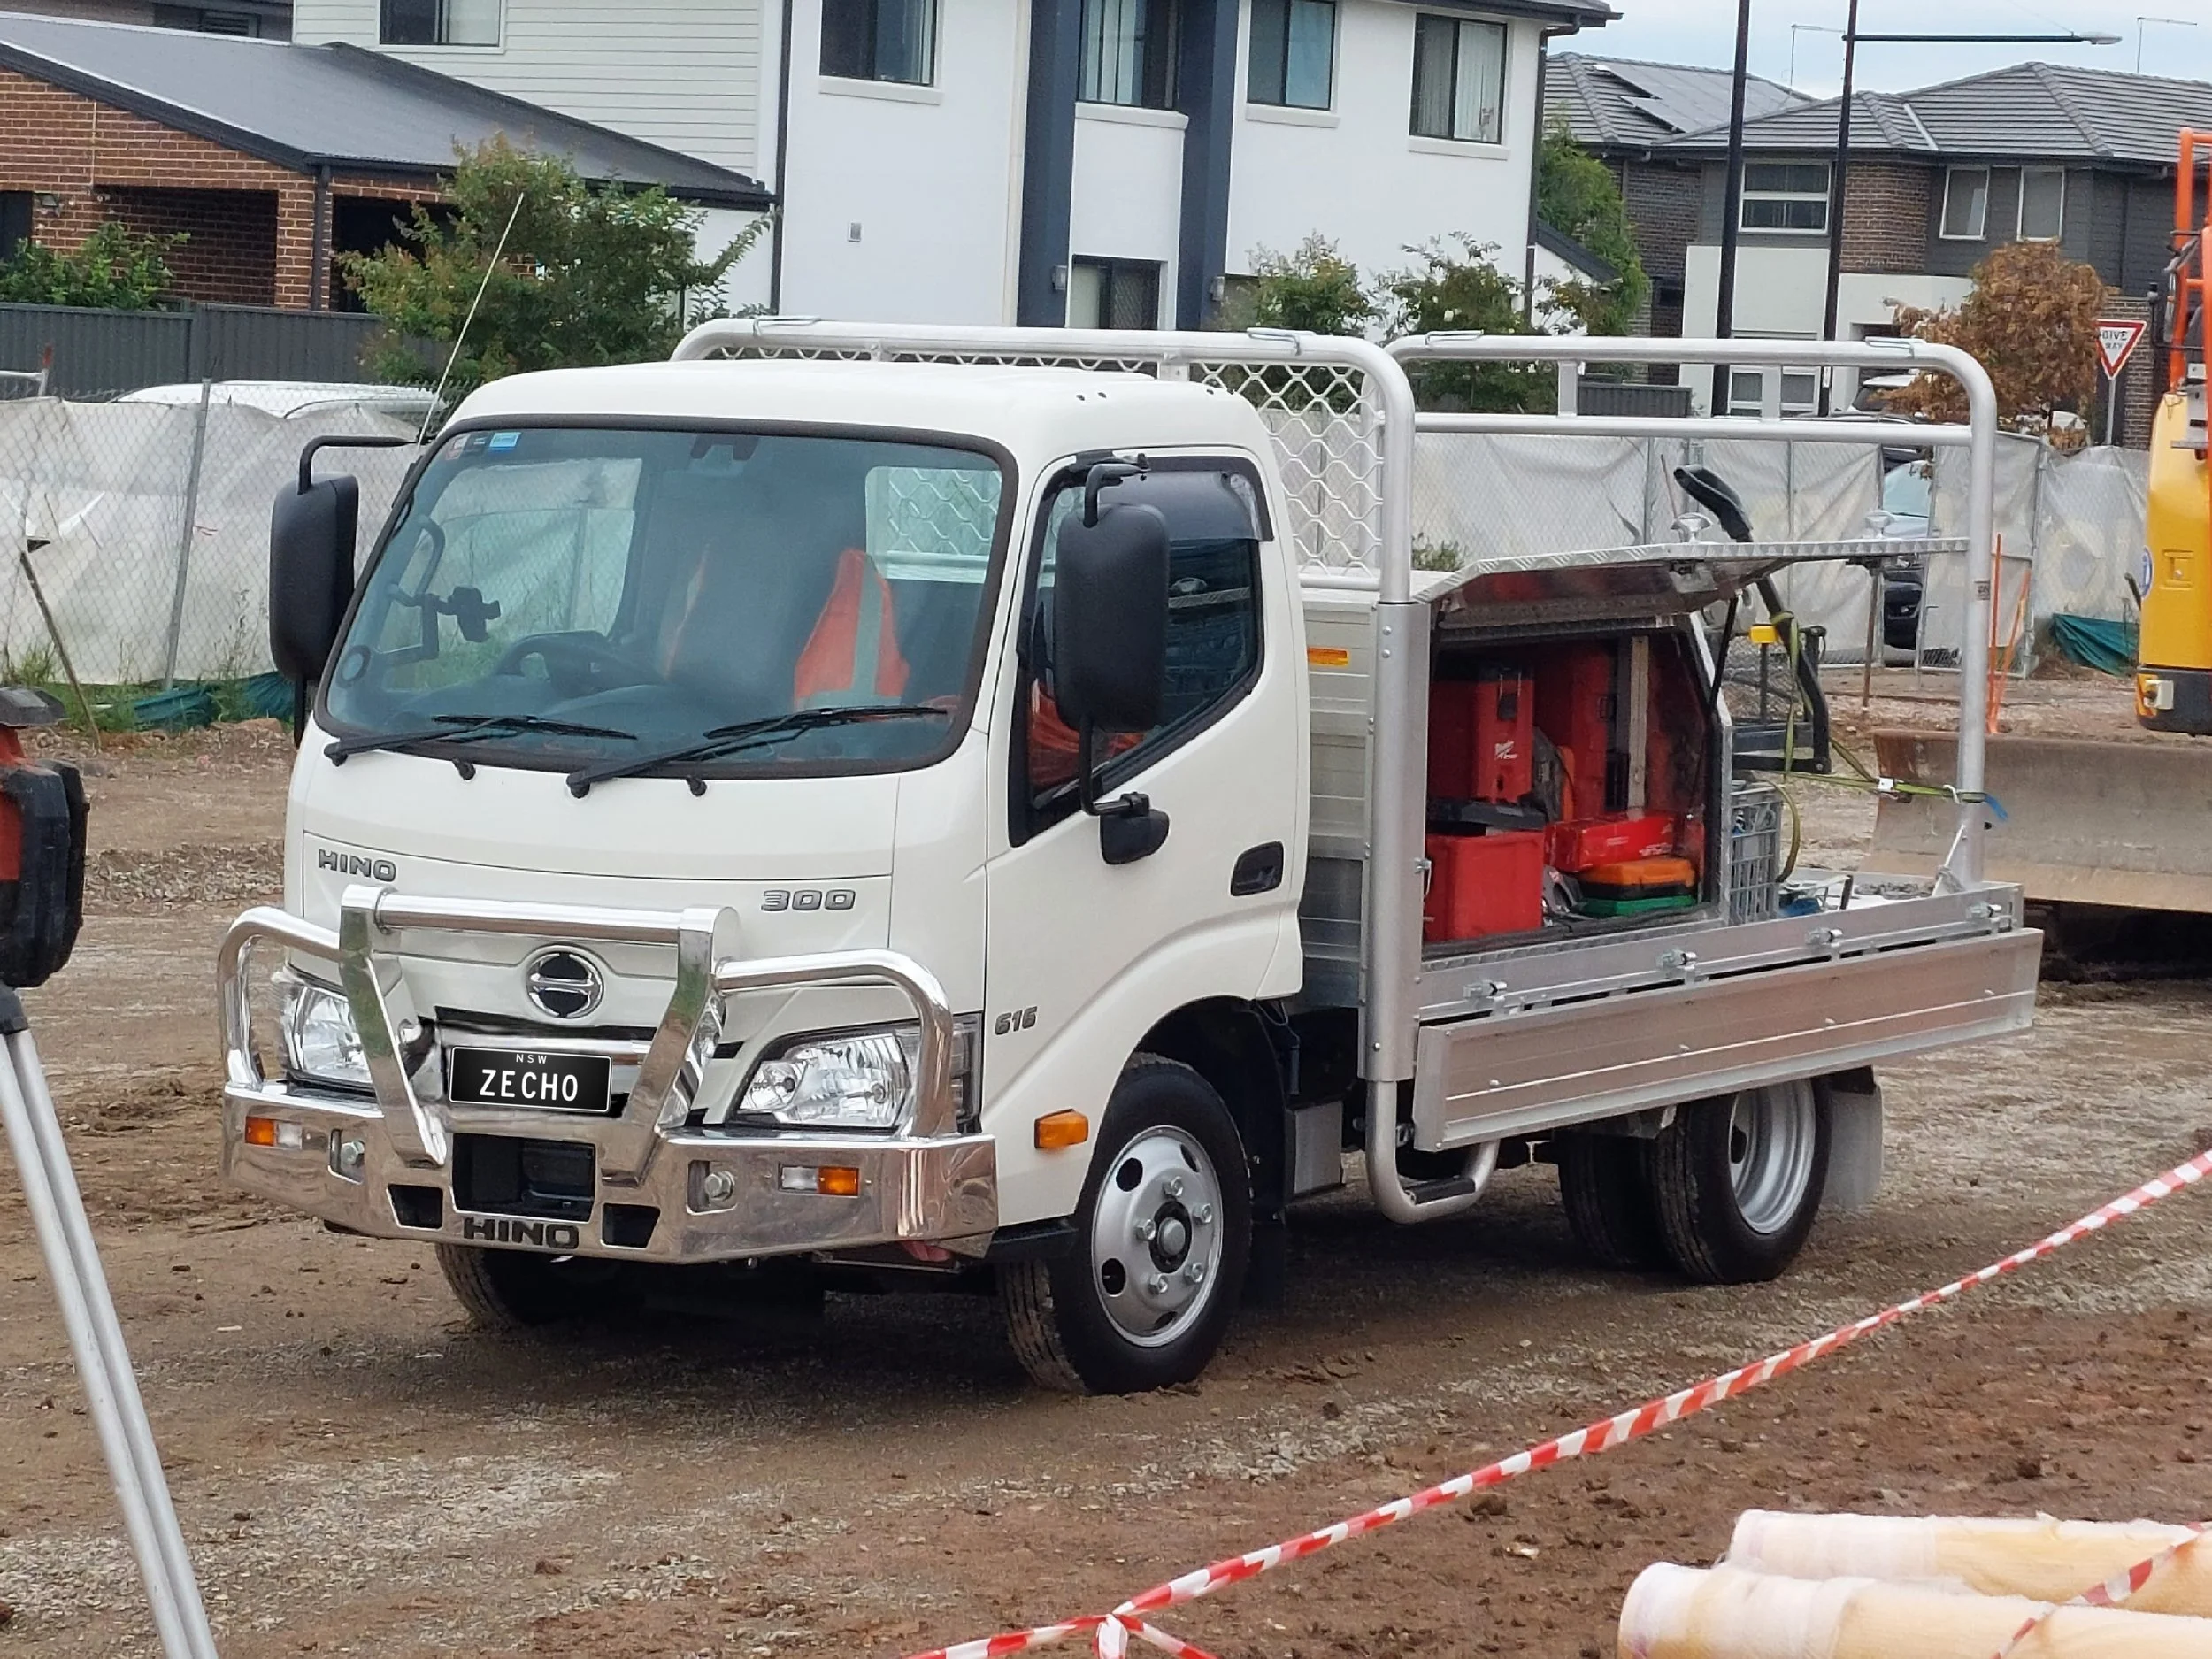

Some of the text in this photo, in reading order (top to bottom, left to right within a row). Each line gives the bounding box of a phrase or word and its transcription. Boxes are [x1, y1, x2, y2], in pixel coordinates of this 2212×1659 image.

[319, 849, 396, 882] HINO
[761, 889, 856, 911] 300
[995, 1006, 1038, 1035] 616
[516, 1053, 547, 1064] NSW
[480, 1069, 578, 1102] ZECHO
[463, 1217, 580, 1249] HINO
